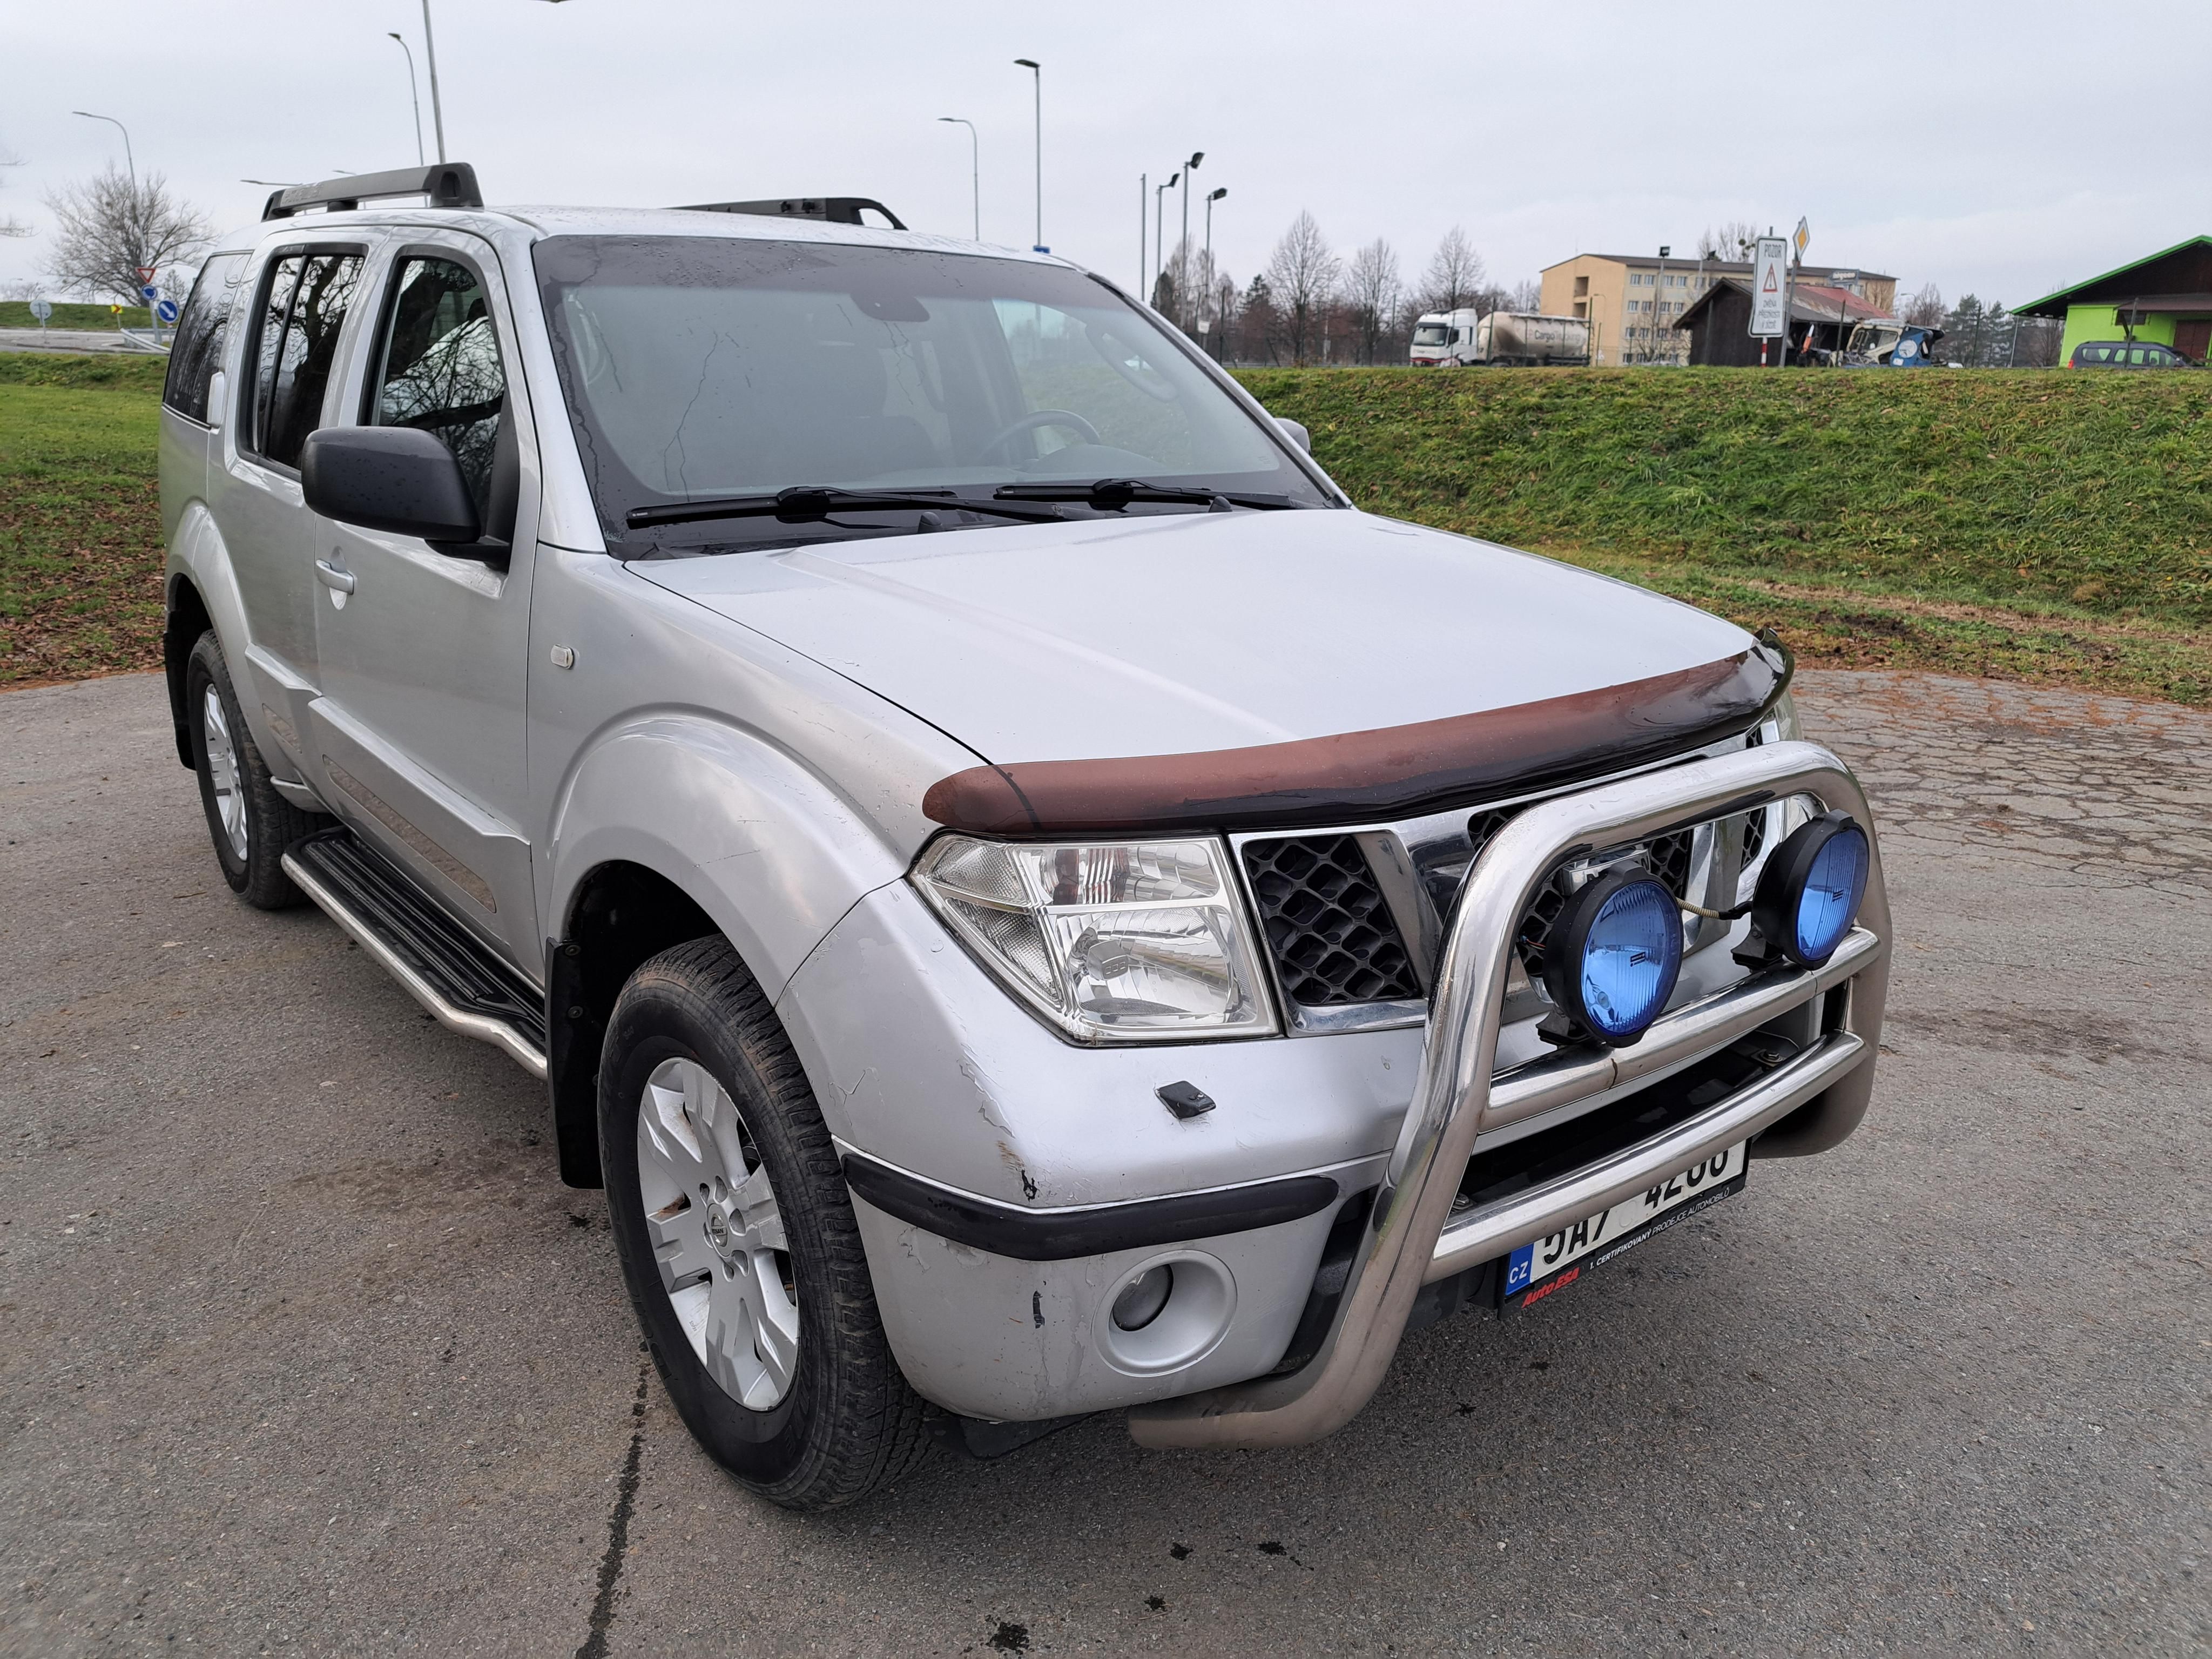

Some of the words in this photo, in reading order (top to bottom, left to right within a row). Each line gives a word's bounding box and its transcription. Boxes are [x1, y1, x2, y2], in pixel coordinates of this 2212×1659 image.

[1596, 1228, 1652, 1266] CERTIFIKOVANÝ
[1652, 1210, 1688, 1236] PRODEJCE
[1687, 1186, 1730, 1216] AUTOMOBILŮ
[1509, 1261, 1528, 1284] CZ
